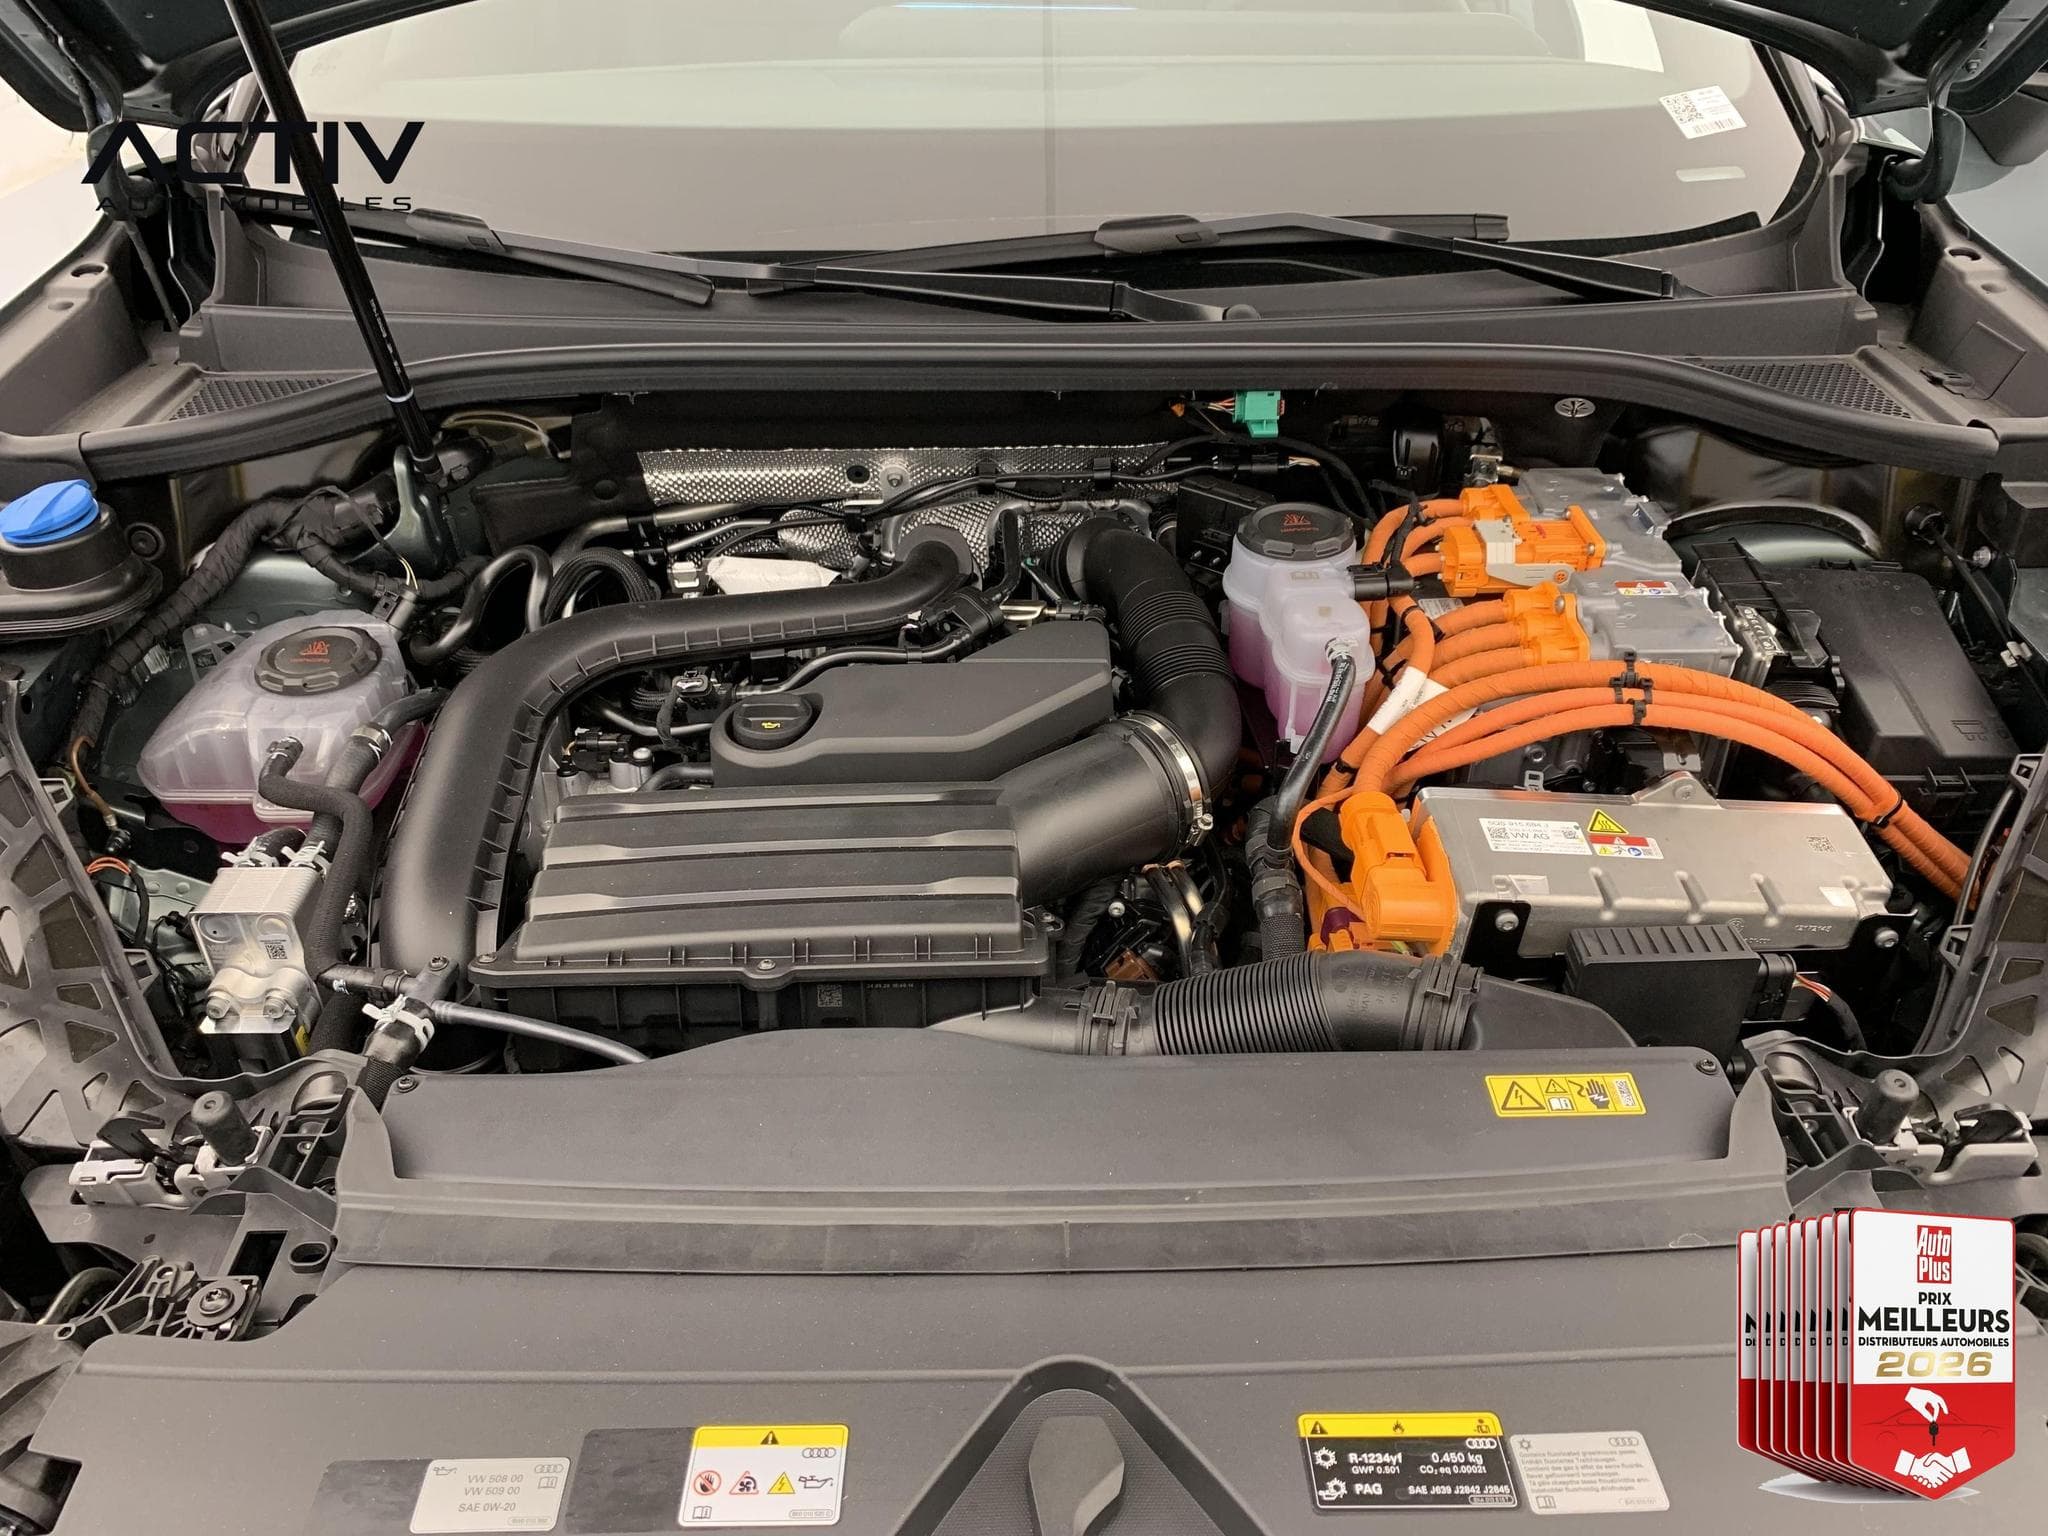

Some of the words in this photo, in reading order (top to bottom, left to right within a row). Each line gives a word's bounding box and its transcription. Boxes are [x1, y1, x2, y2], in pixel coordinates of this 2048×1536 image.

[1348, 1452, 1402, 1465] R-1234yf
[1431, 1452, 1465, 1463] 0.450
[1467, 1452, 1484, 1465] kg
[1351, 1466, 1374, 1474] GWP
[1377, 1466, 1400, 1474] 0.501
[1439, 1466, 1452, 1475] eq
[468, 1475, 486, 1484] VW
[488, 1474, 508, 1483] 508
[510, 1474, 524, 1483] 00
[464, 1487, 483, 1496] VW
[485, 1487, 504, 1496] 509
[507, 1486, 520, 1495] 00
[1354, 1483, 1383, 1495] PAG
[1408, 1486, 1428, 1494] SAE
[1430, 1485, 1452, 1494] J639
[1454, 1485, 1481, 1494] J2842
[458, 1503, 481, 1512] SAE
[483, 1503, 516, 1512] 0W-20
